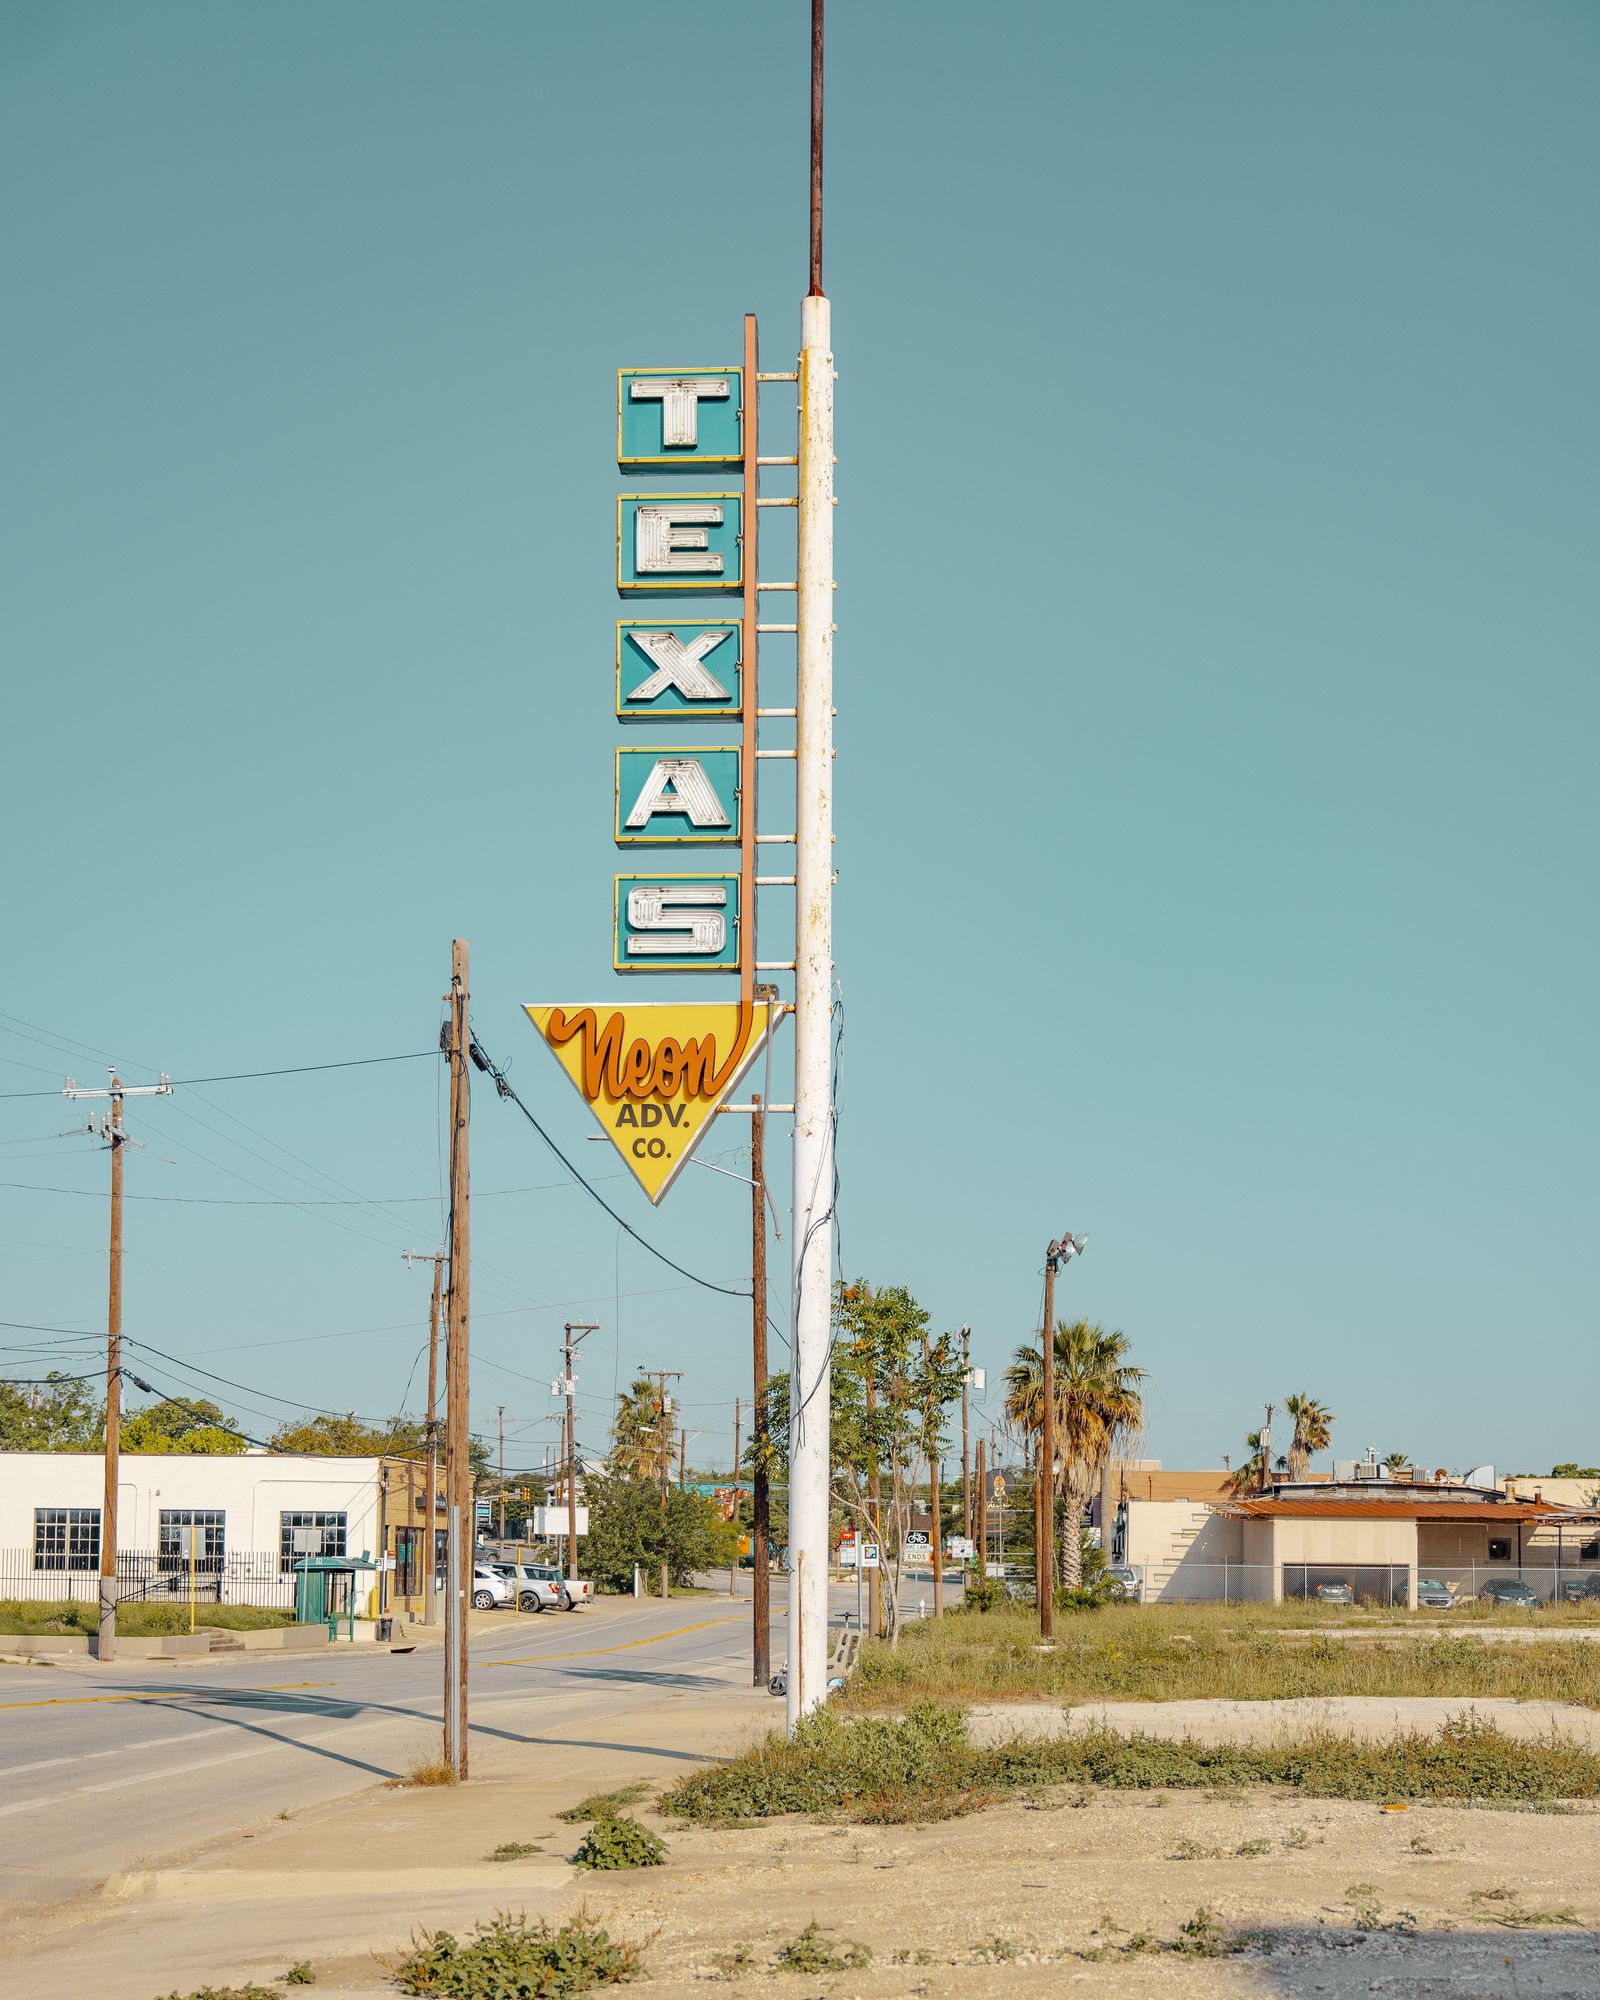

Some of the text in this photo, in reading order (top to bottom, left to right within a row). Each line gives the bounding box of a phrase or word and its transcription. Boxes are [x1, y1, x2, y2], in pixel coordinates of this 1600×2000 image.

[626, 378, 734, 955] TEXAS
[549, 1007, 750, 1099] Neon
[615, 1103, 690, 1128] ADV.
[632, 1137, 672, 1159] CO.
